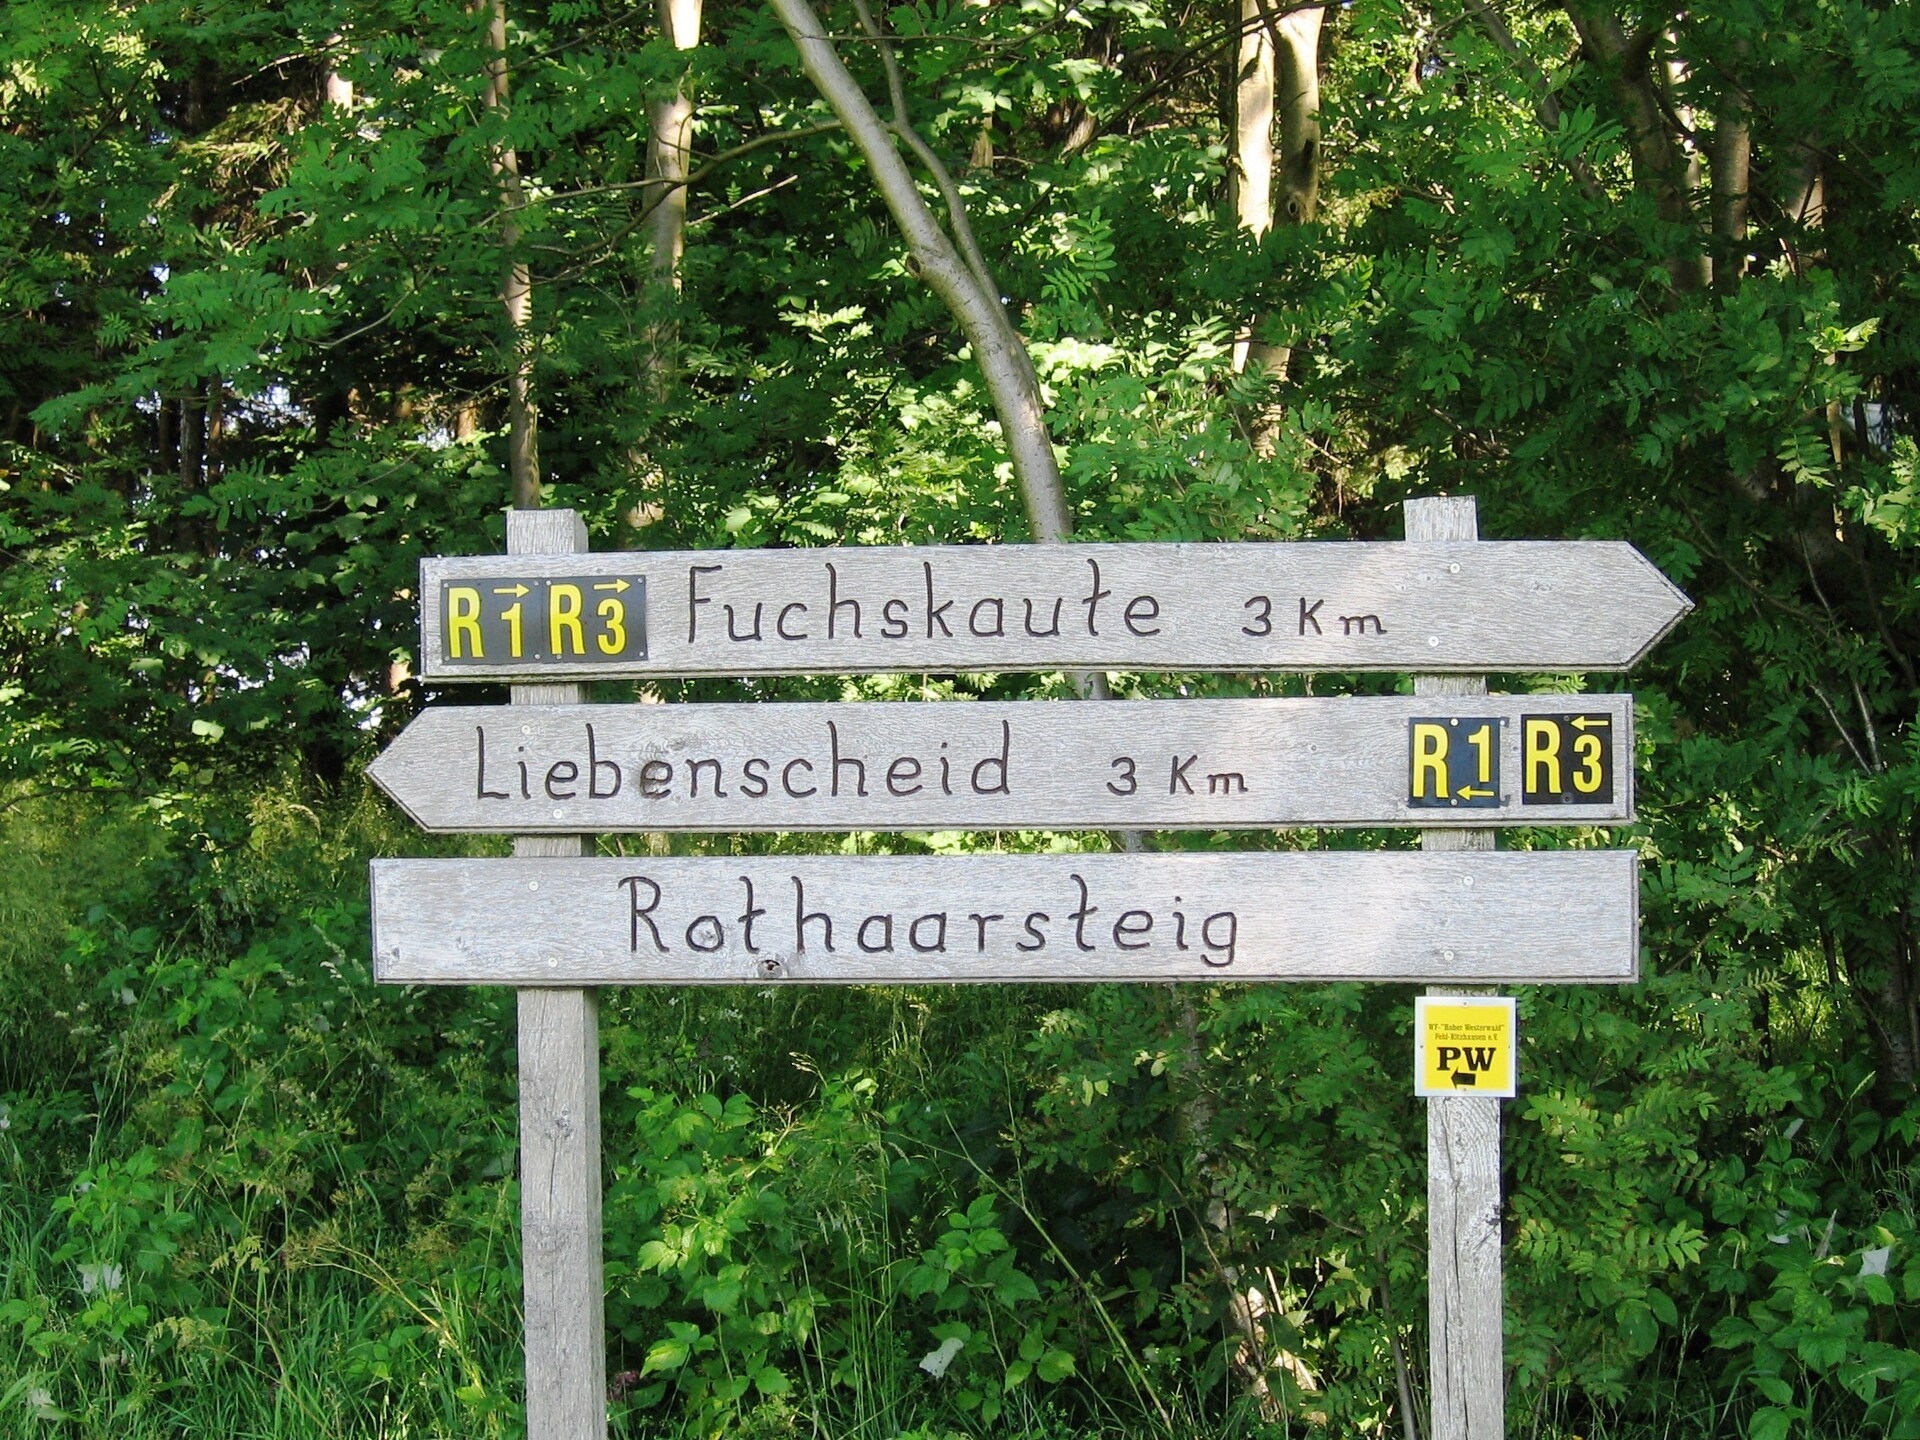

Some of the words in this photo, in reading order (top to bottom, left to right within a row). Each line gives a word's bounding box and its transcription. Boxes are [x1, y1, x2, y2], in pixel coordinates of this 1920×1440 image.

[688, 558, 1160, 643] Fuchskaute
[1242, 595, 1272, 637] 3
[476, 720, 1010, 800] Liebenscheid
[1106, 756, 1137, 796] 3
[617, 874, 1238, 967] Rothaarsteig
[1436, 1046, 1497, 1071] PW
